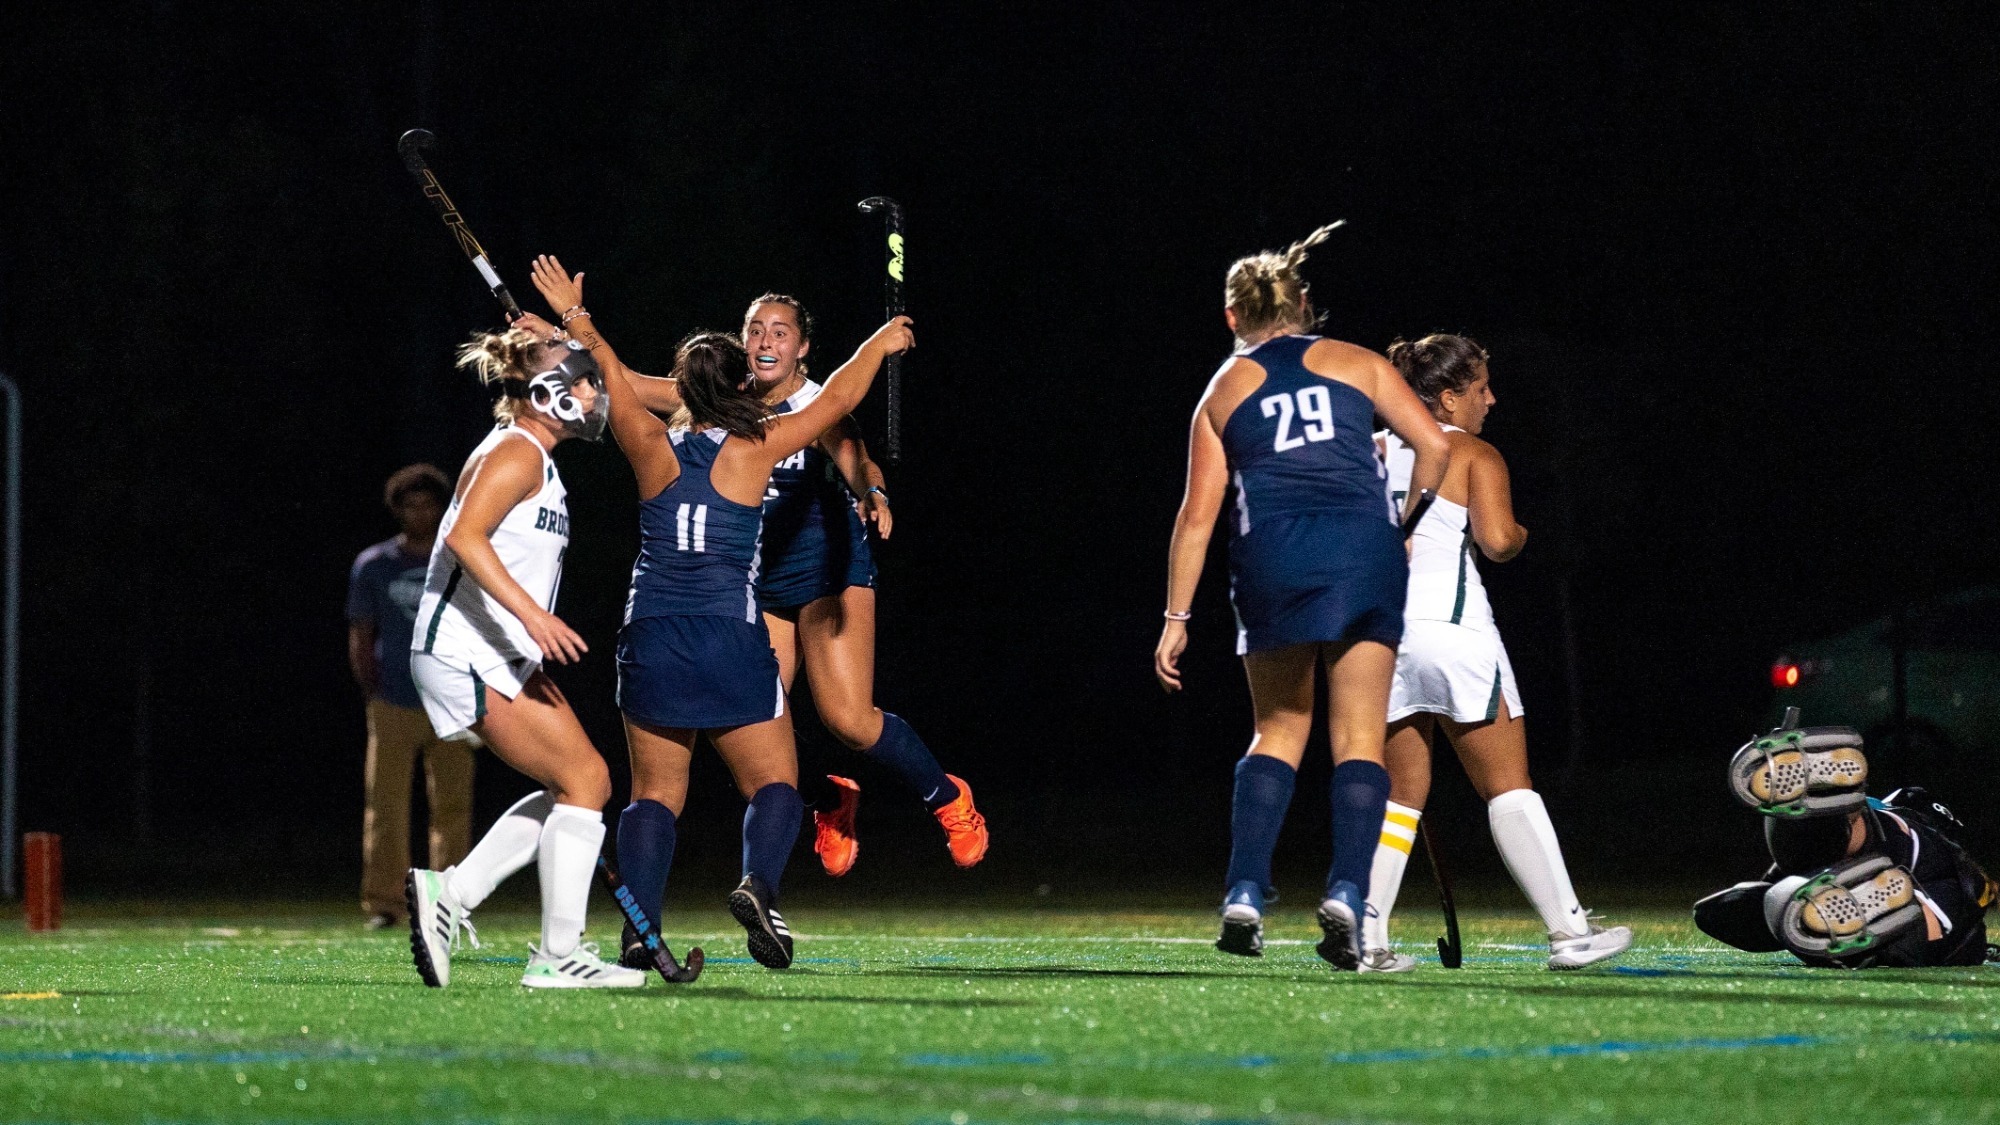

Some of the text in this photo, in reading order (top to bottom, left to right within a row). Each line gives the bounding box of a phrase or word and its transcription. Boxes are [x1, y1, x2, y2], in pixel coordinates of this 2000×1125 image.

[423, 168, 489, 261] TK
[1260, 385, 1335, 453] 29
[676, 503, 708, 552] 11
[614, 885, 650, 935] OSAKA
